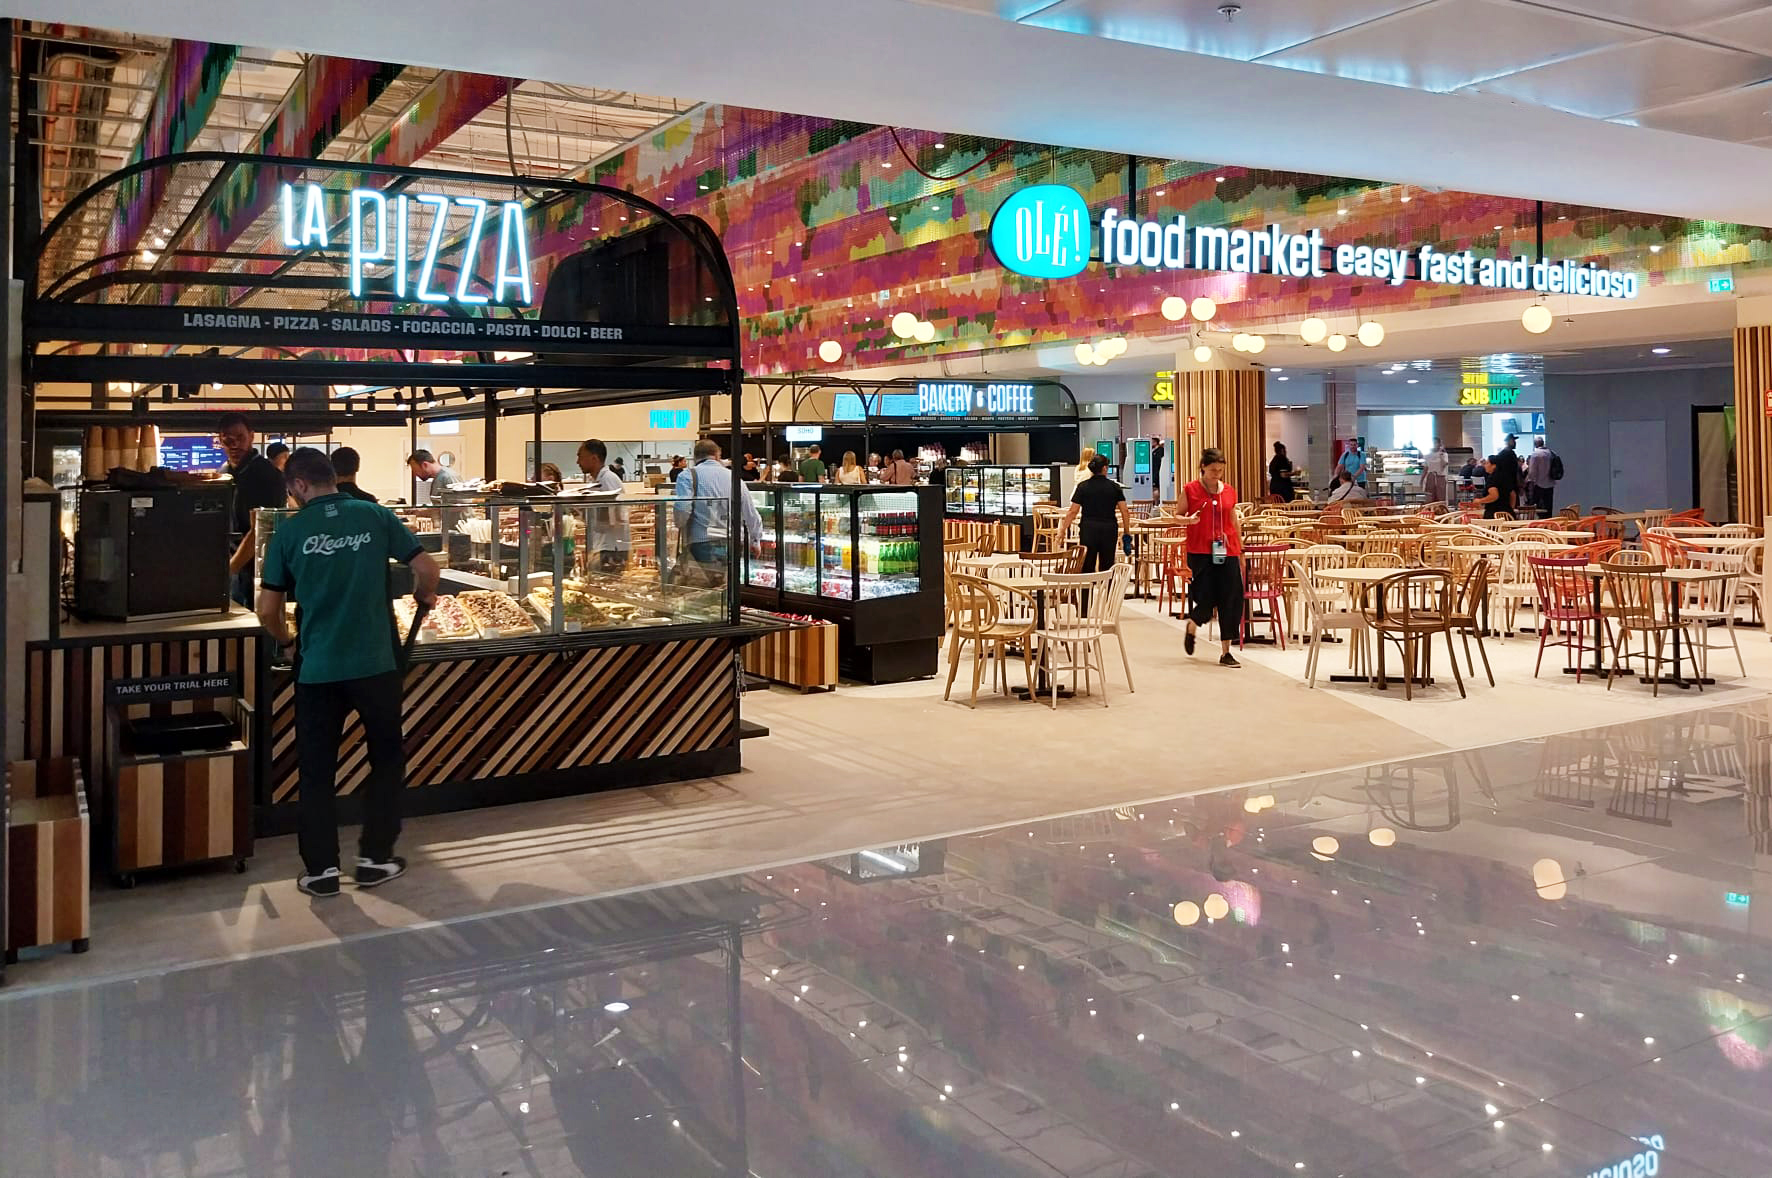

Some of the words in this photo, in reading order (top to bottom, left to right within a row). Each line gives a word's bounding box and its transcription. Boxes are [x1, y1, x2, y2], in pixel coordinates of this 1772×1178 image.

[282, 183, 329, 248] LA
[350, 189, 532, 305] PIZZA
[1015, 200, 1081, 267] OLÉ!
[1100, 208, 1185, 269] food
[1195, 223, 1323, 278] market
[1336, 244, 1407, 285] easy
[1420, 245, 1476, 286] fast
[1479, 255, 1527, 290] and
[1533, 259, 1638, 298] delicioso
[183, 313, 262, 329] LASAGNA
[273, 316, 320, 330] PIZZA
[331, 318, 391, 332] SALADS
[402, 320, 475, 335] FOCACCIA
[486, 323, 531, 337] PASTA
[541, 325, 581, 338] DOLCI
[590, 327, 623, 340] BEER
[919, 384, 973, 412] BAKERY
[987, 384, 1034, 412] COFFEE
[1460, 387, 1520, 405] SUBWAY
[116, 685, 142, 695] TAKE
[144, 683, 171, 692] YOUR
[174, 680, 201, 690] TRIAL
[203, 678, 229, 687] HERE
